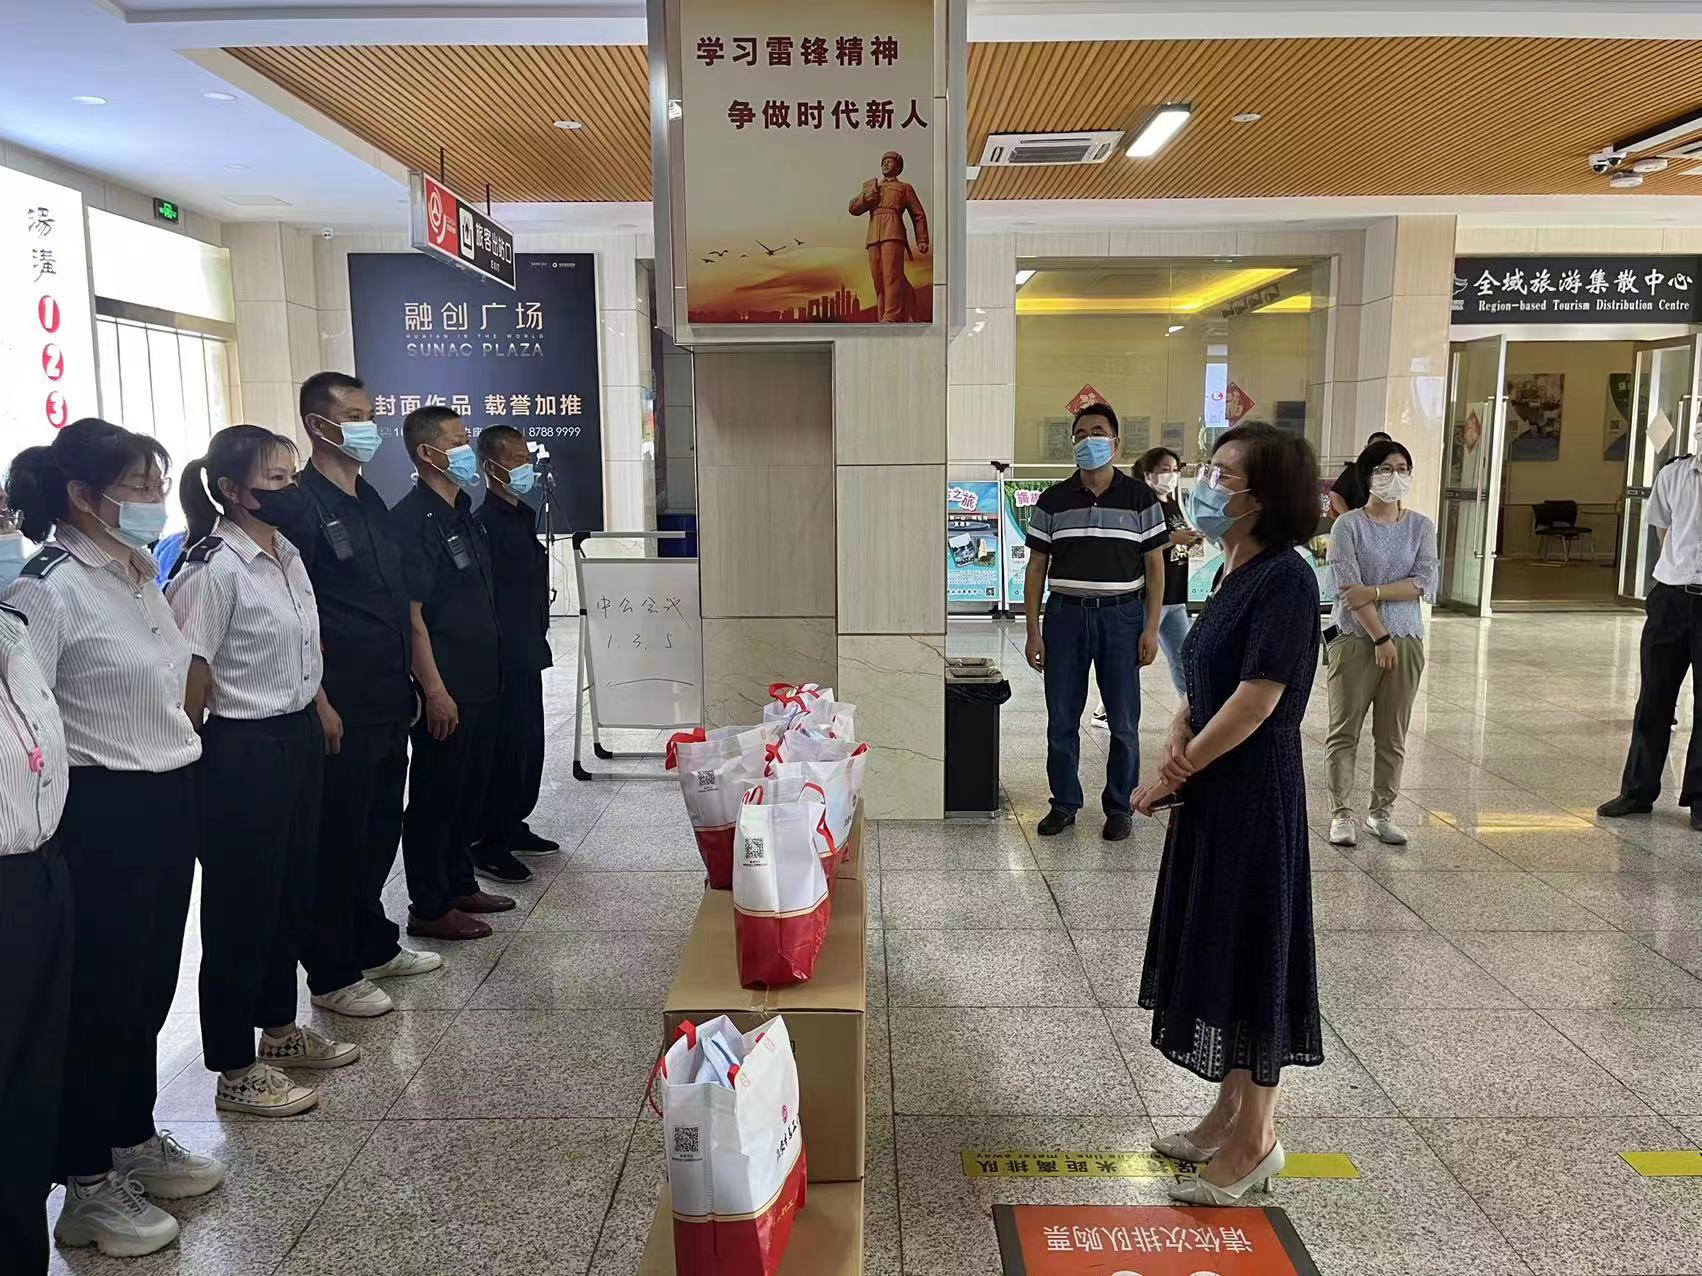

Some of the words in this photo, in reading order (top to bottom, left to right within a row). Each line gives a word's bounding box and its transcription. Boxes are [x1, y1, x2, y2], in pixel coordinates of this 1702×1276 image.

[696, 36, 899, 67] 学习雷锋精神
[727, 99, 929, 130] 争做时代新人
[475, 222, 512, 265] 旅客出站口
[490, 259, 501, 273] EXIT
[1473, 268, 1694, 296] 全域旅游集散中心
[403, 301, 544, 331] 融创广场
[1478, 299, 1547, 314] Region-based
[1553, 299, 1590, 311] Tourism
[1596, 299, 1653, 311] Distribution
[1658, 299, 1690, 311] Centre
[406, 342, 473, 357] SUNAC
[482, 342, 544, 357] PLAZA
[484, 394, 583, 416] 载誉加推
[528, 426, 553, 438] 8788
[556, 426, 581, 438] 9999
[1043, 1225, 1253, 1253] 请依次排队购票
